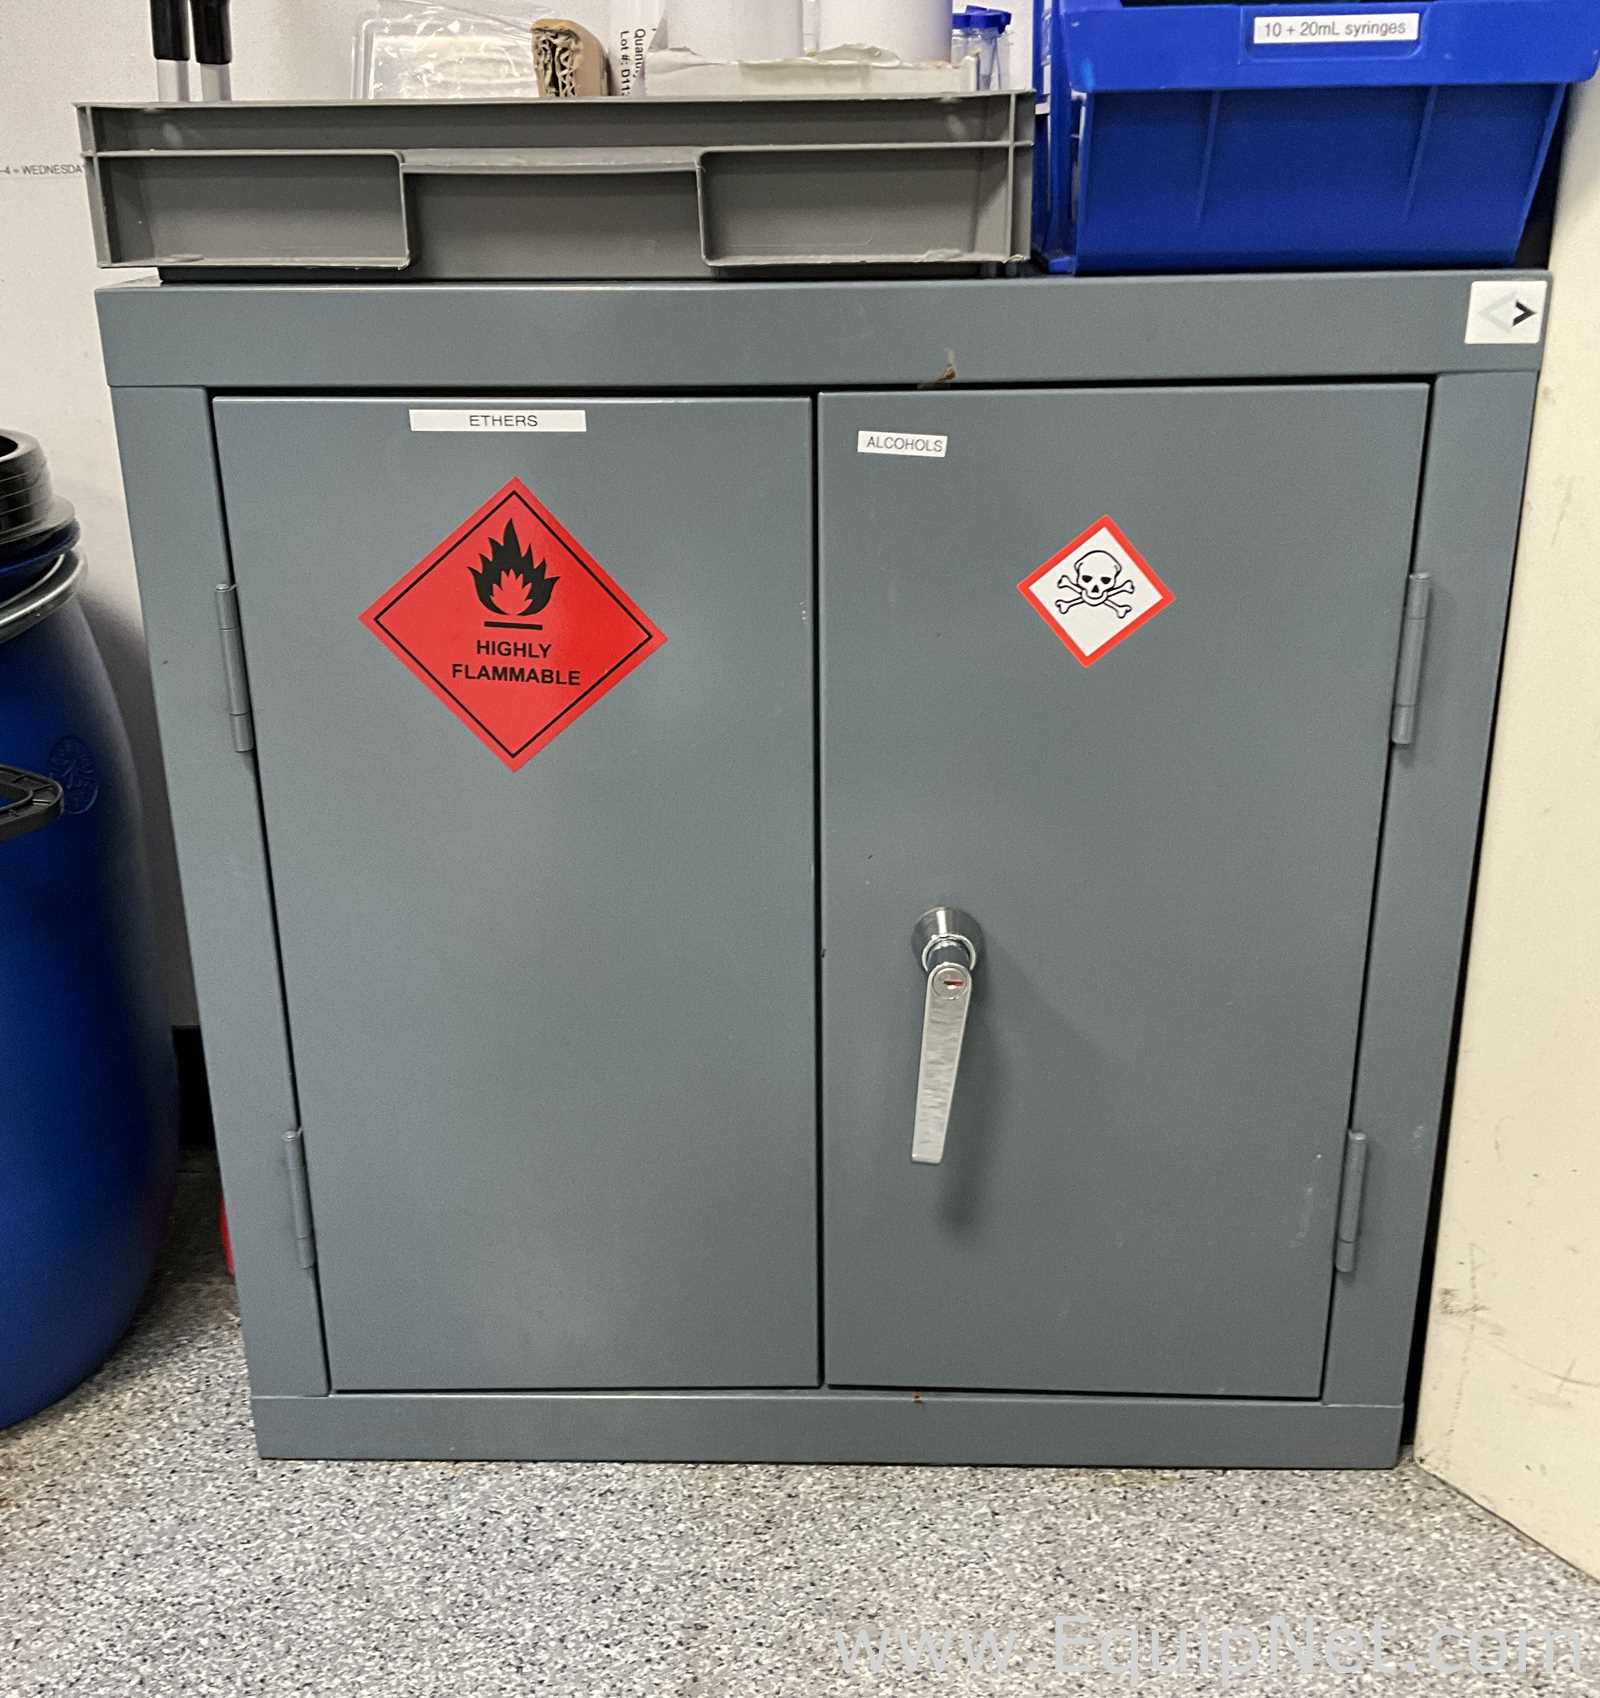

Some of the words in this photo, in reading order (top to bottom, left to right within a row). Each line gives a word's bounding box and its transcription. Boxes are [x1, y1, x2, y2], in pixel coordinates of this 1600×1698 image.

[1264, 22, 1282, 38] 10
[1286, 26, 1297, 36] +
[1300, 21, 1340, 37] 20mL
[1344, 20, 1406, 38] syringes
[620, 30, 630, 51] Lot
[22, 164, 84, 176] WEDNESDA
[469, 414, 538, 427] ETHERS
[866, 435, 944, 453] ALCOHOLS
[476, 639, 552, 659] HIGHLY
[451, 663, 582, 686] FLAMMABLE
